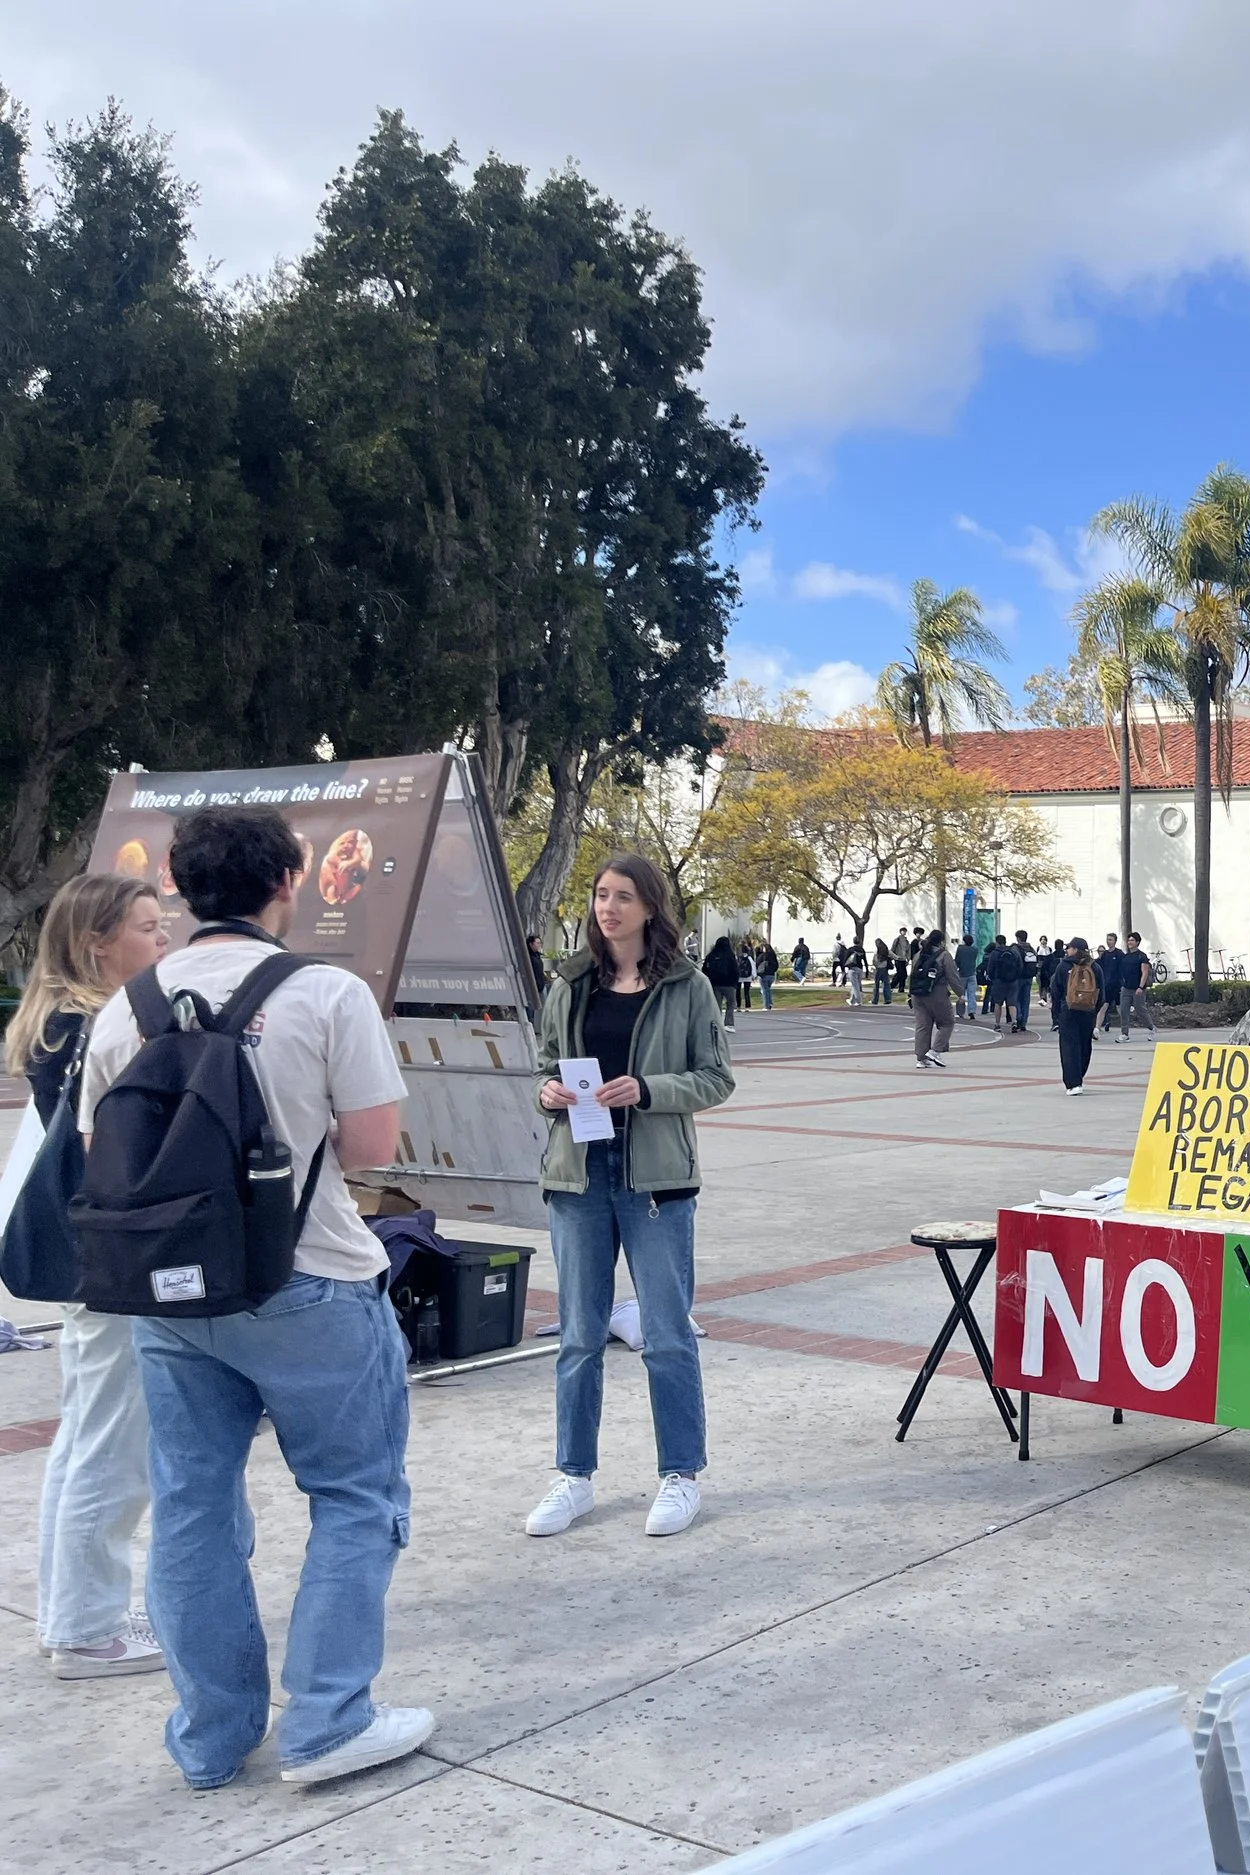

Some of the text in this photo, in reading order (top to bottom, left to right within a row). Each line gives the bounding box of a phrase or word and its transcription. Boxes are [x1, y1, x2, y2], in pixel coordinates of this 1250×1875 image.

[130, 790, 181, 808] Where
[183, 788, 206, 807] do
[208, 791, 241, 806] you
[243, 786, 289, 804] draw
[290, 783, 320, 802] the
[323, 778, 369, 799] line?
[1021, 1249, 1197, 1392] NO
